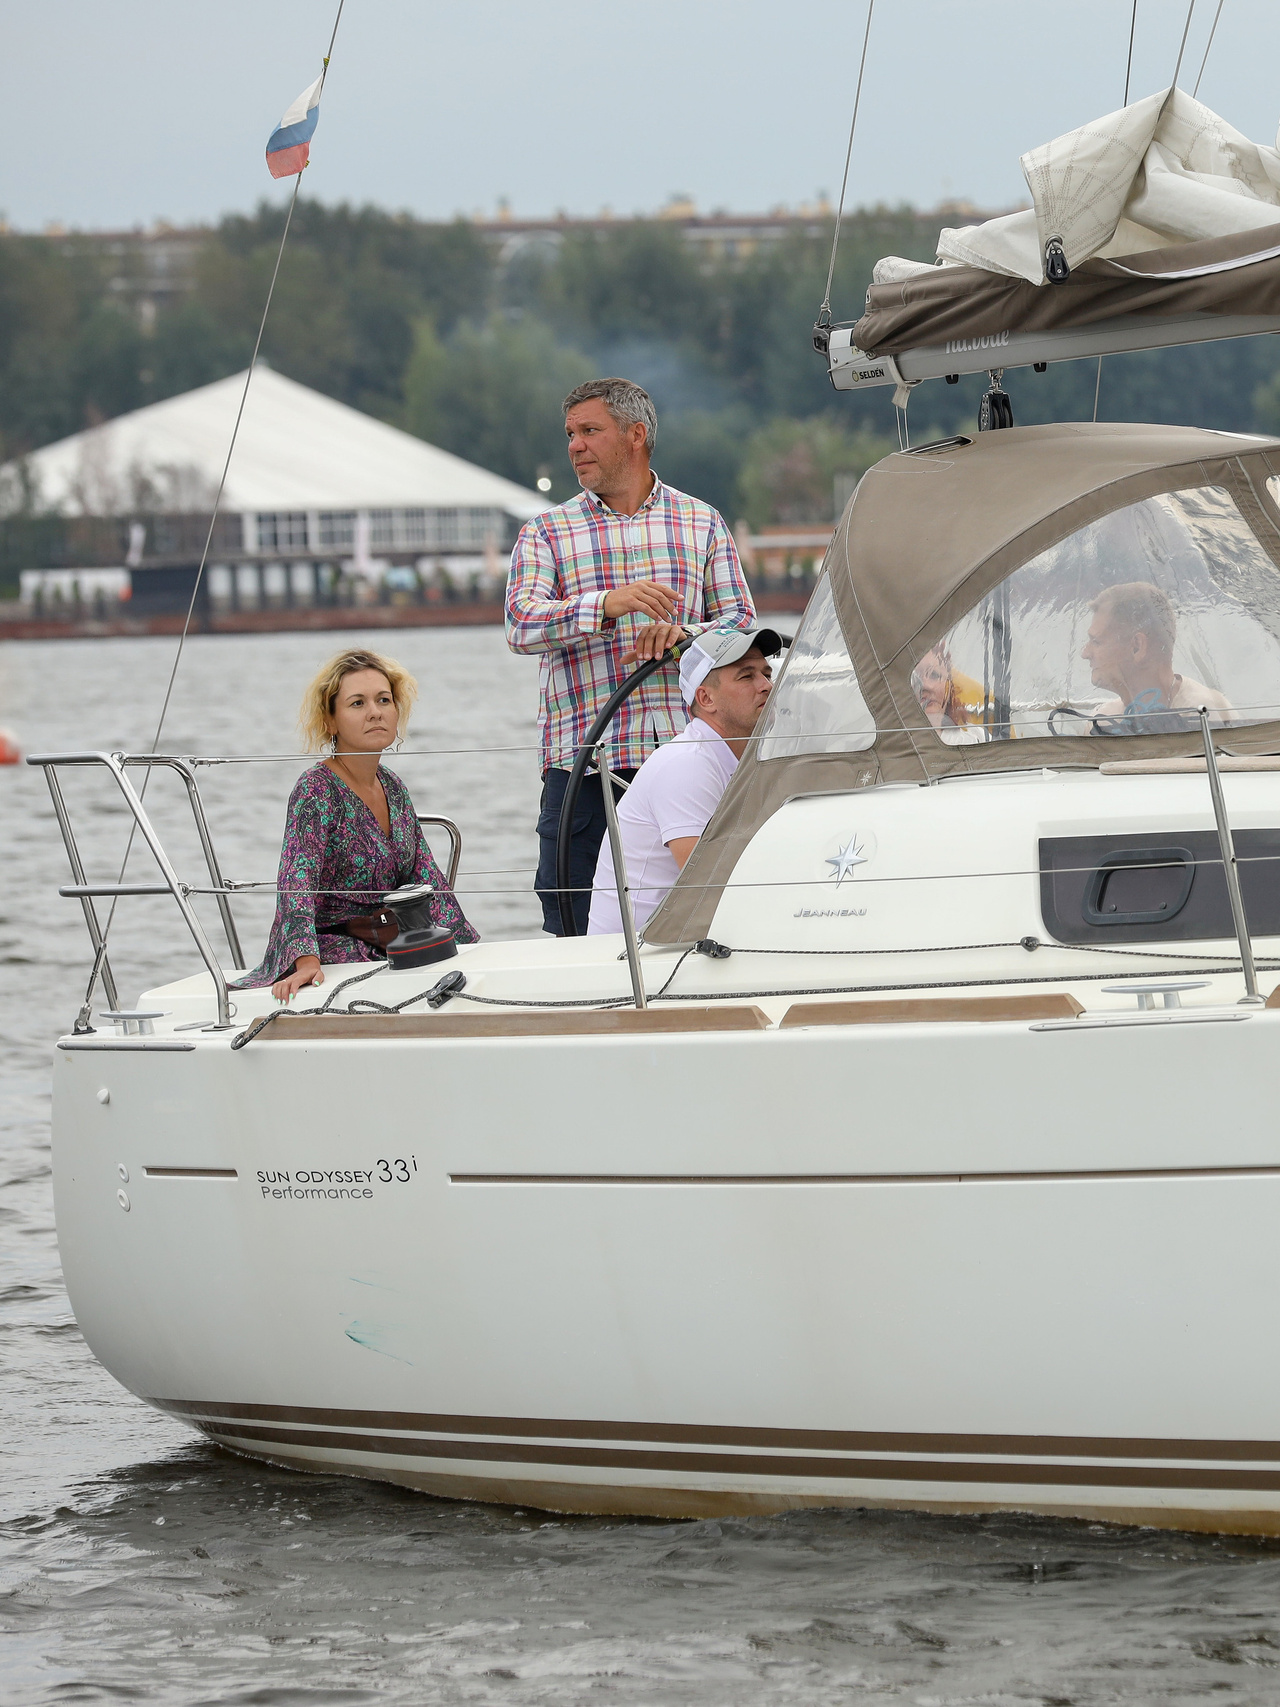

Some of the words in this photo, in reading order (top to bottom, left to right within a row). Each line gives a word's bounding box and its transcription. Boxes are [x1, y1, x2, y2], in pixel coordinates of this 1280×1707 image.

[793, 907, 868, 918] JEANNEAU
[256, 1170, 291, 1183] SUN
[295, 1170, 374, 1183] ODYSSEY
[260, 1185, 374, 1200] Performance
